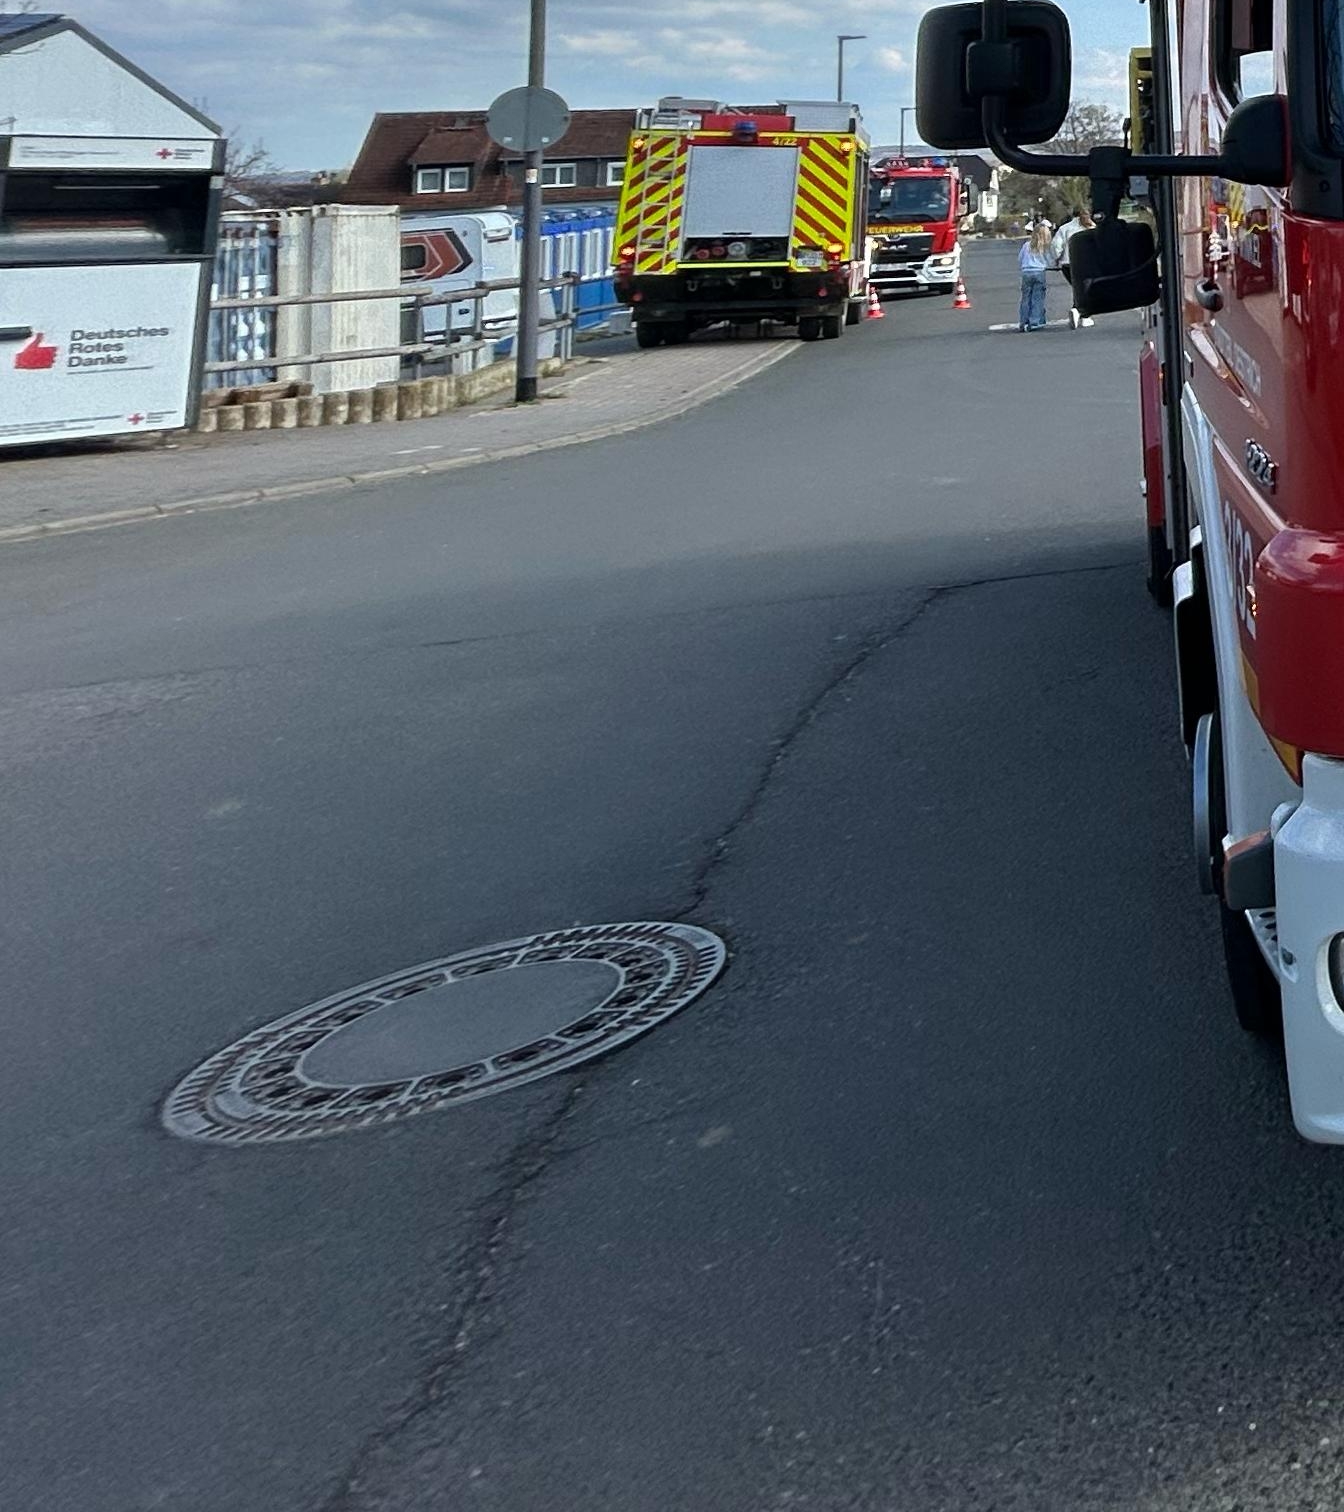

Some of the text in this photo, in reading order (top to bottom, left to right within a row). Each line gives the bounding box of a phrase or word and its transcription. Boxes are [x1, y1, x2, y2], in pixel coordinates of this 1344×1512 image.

[70, 326, 169, 342] Deutsches
[68, 342, 124, 355] Rotes
[66, 354, 128, 368] Danke
